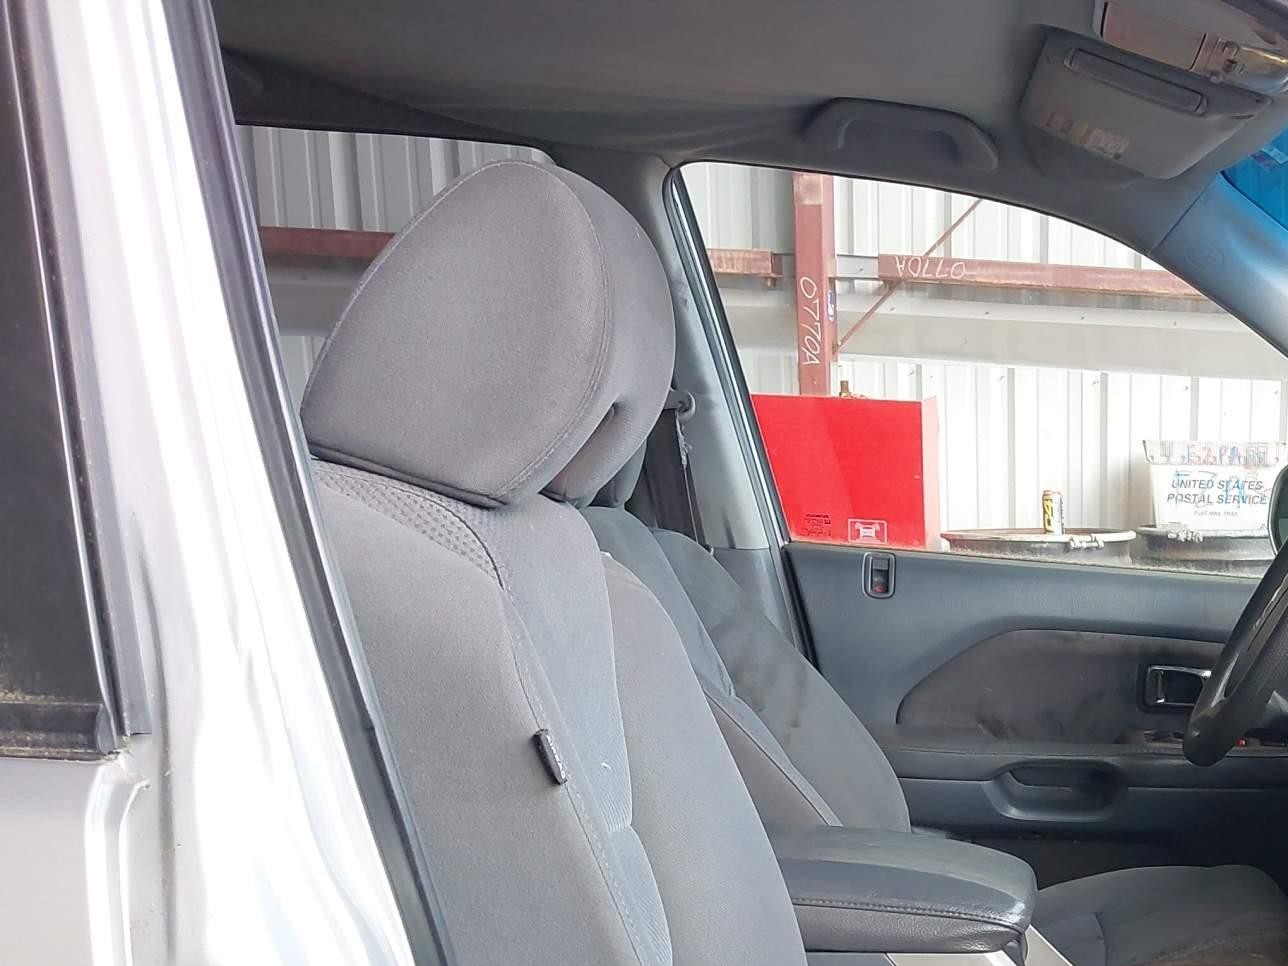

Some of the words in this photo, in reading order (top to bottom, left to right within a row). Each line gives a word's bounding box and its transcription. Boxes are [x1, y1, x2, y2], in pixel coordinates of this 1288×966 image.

[1171, 479, 1214, 489] UNITED
[1217, 479, 1264, 490] STATES
[1166, 493, 1213, 504] POSTAL
[1217, 494, 1268, 505] SERVICE
